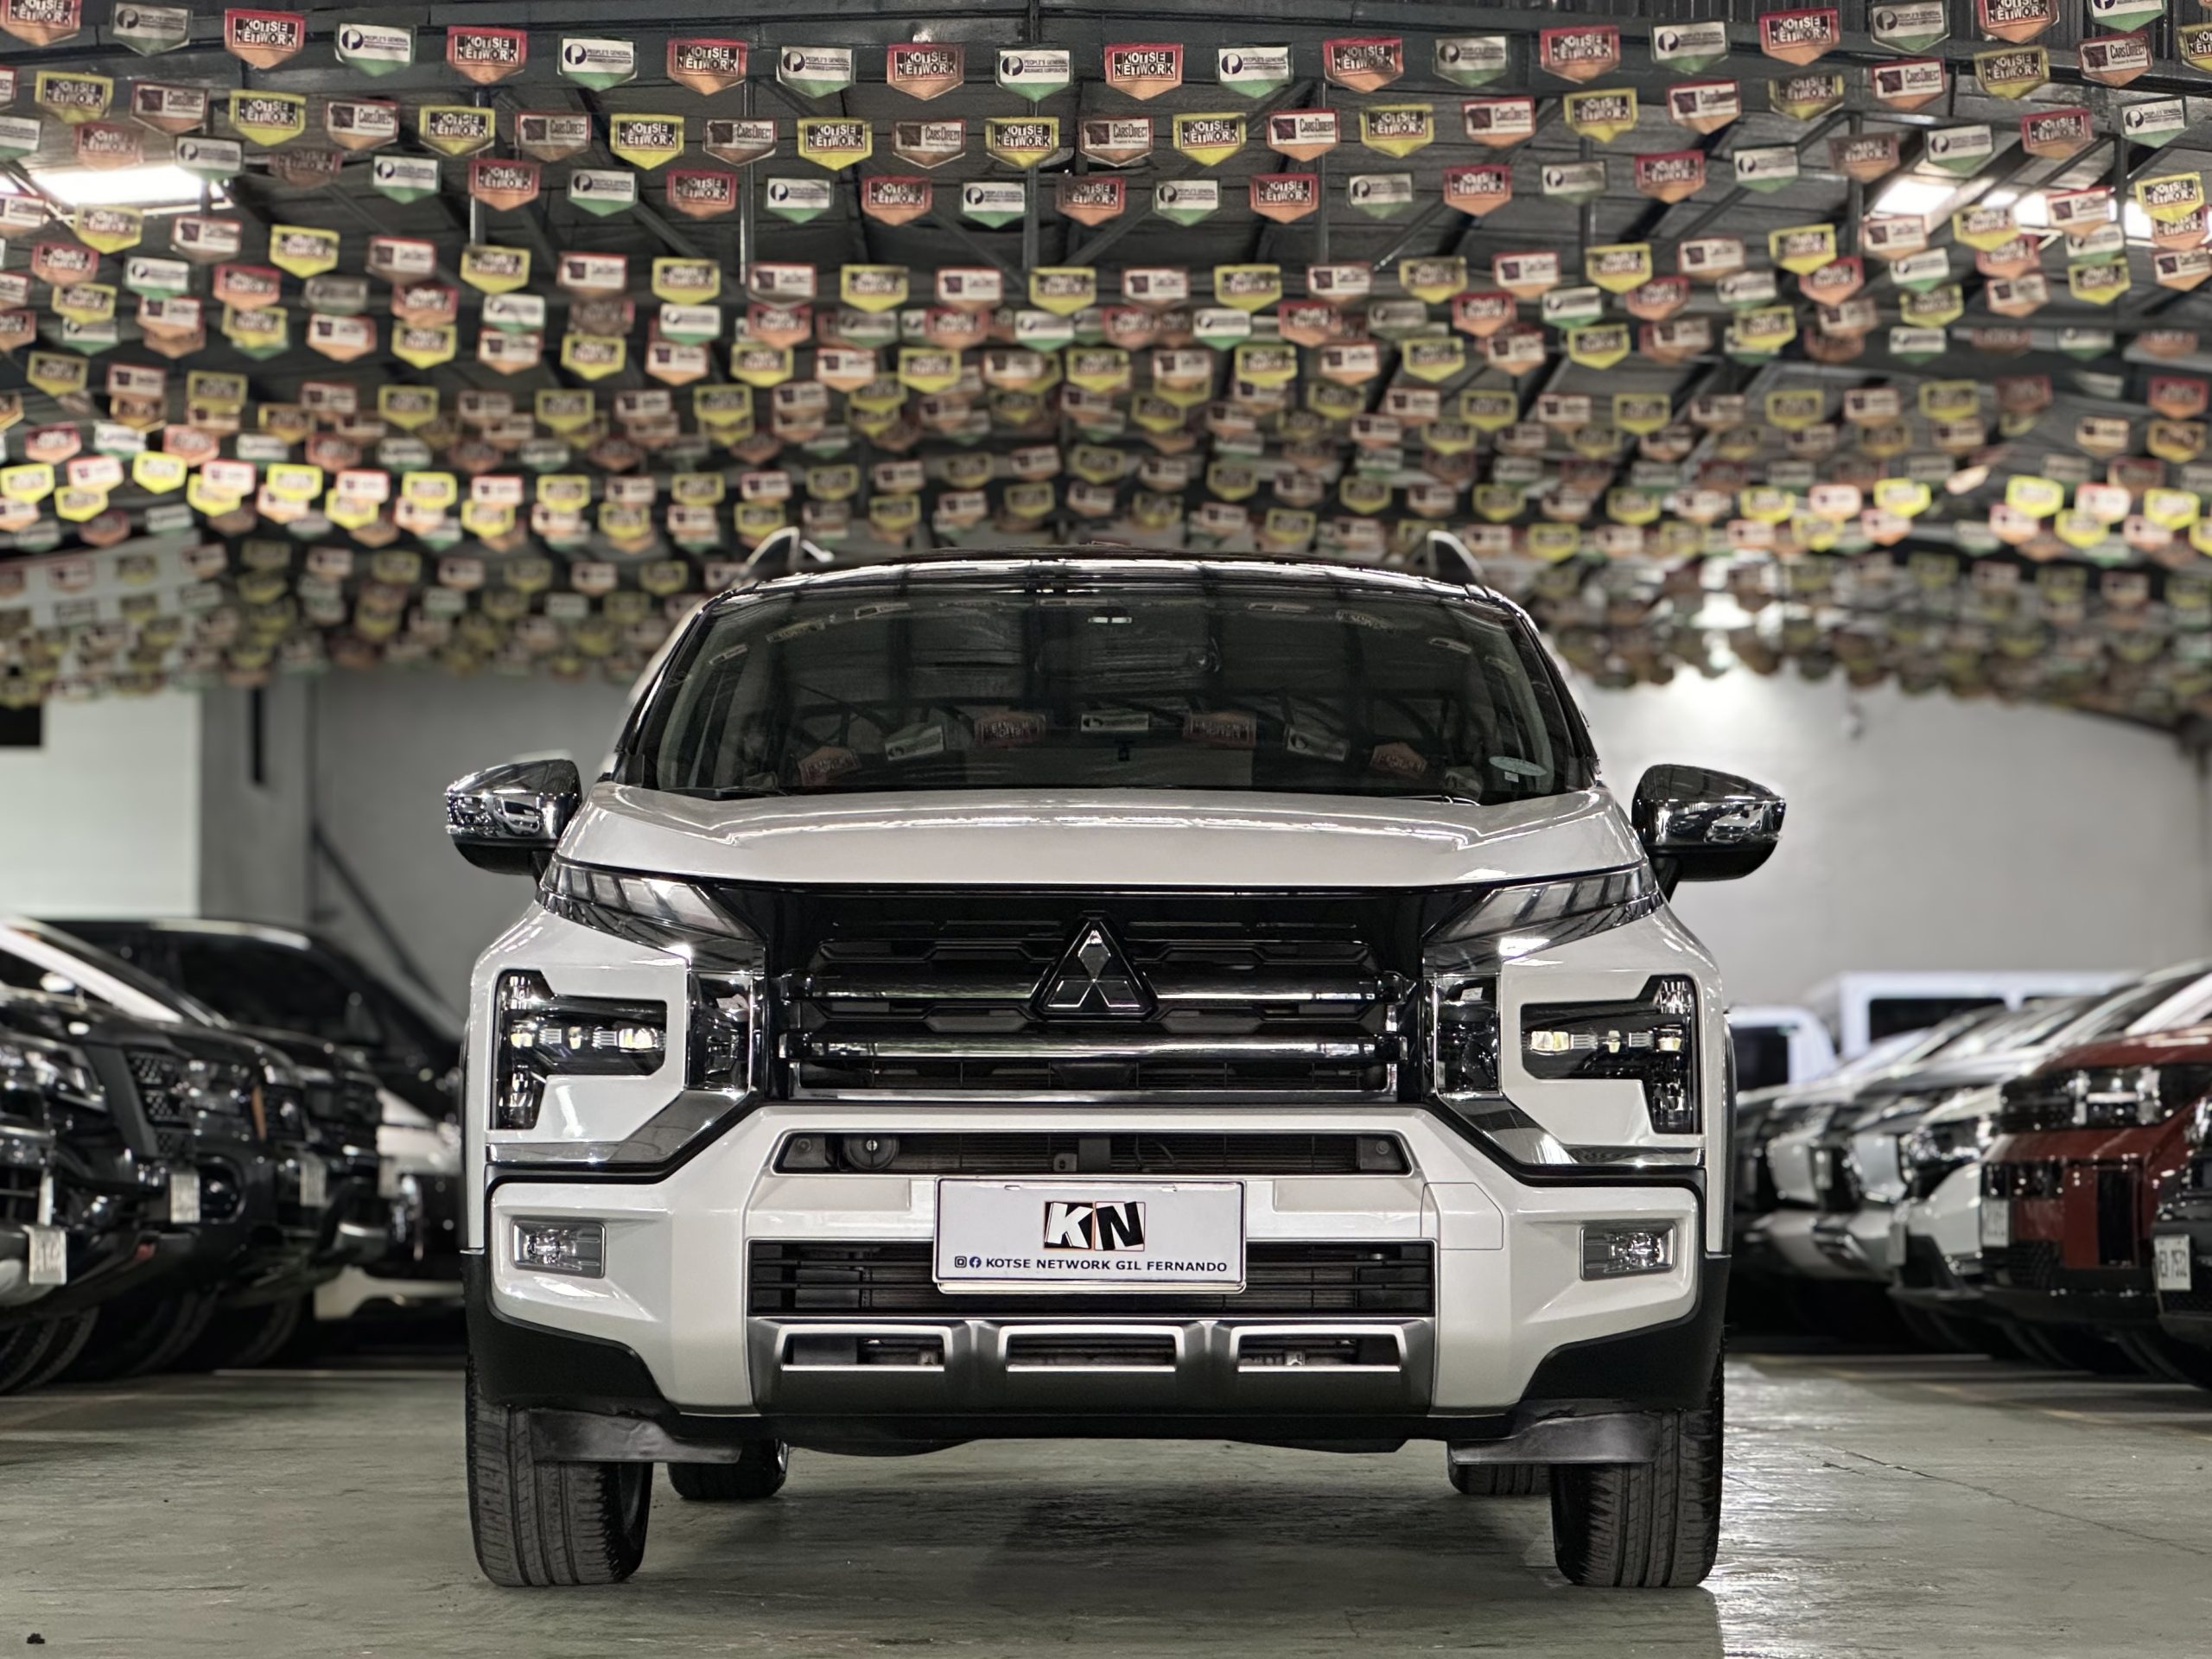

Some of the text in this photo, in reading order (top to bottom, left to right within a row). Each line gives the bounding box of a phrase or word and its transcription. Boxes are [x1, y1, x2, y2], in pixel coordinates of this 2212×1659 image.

[1988, 4, 2048, 22] NETWORK
[245, 19, 289, 32] KOTSE
[1779, 16, 1821, 29] KOTSE
[236, 29, 295, 46] NETWORK
[466, 35, 510, 48] KOTSE
[1771, 27, 1829, 43] NETWORK
[456, 47, 517, 61] NETWORK
[686, 45, 728, 58] KOTSE
[906, 51, 948, 62] KOTSE
[1123, 52, 1165, 63] KOTSE
[1344, 45, 1385, 58] KOTSE
[677, 57, 736, 71] NETWORK
[1335, 56, 1393, 70] NETWORK
[1992, 54, 2031, 67] KOTSE
[897, 62, 956, 76] NETWORK
[1115, 63, 1173, 76] NETWORK
[438, 112, 480, 125] KOTSE
[429, 123, 486, 137] NETWORK
[628, 121, 667, 133] KOTSE
[816, 124, 856, 136] KOTSE
[1003, 124, 1043, 136] KOTSE
[1189, 121, 1230, 133] KOTSE
[619, 133, 675, 145] NETWORK
[808, 135, 863, 148] NETWORK
[995, 136, 1050, 147] NETWORK
[1182, 130, 1238, 143] NETWORK
[1044, 1200, 1146, 1251] KN
[986, 1258, 1227, 1272] KOTSE NETWORK GIL FERNANDO
